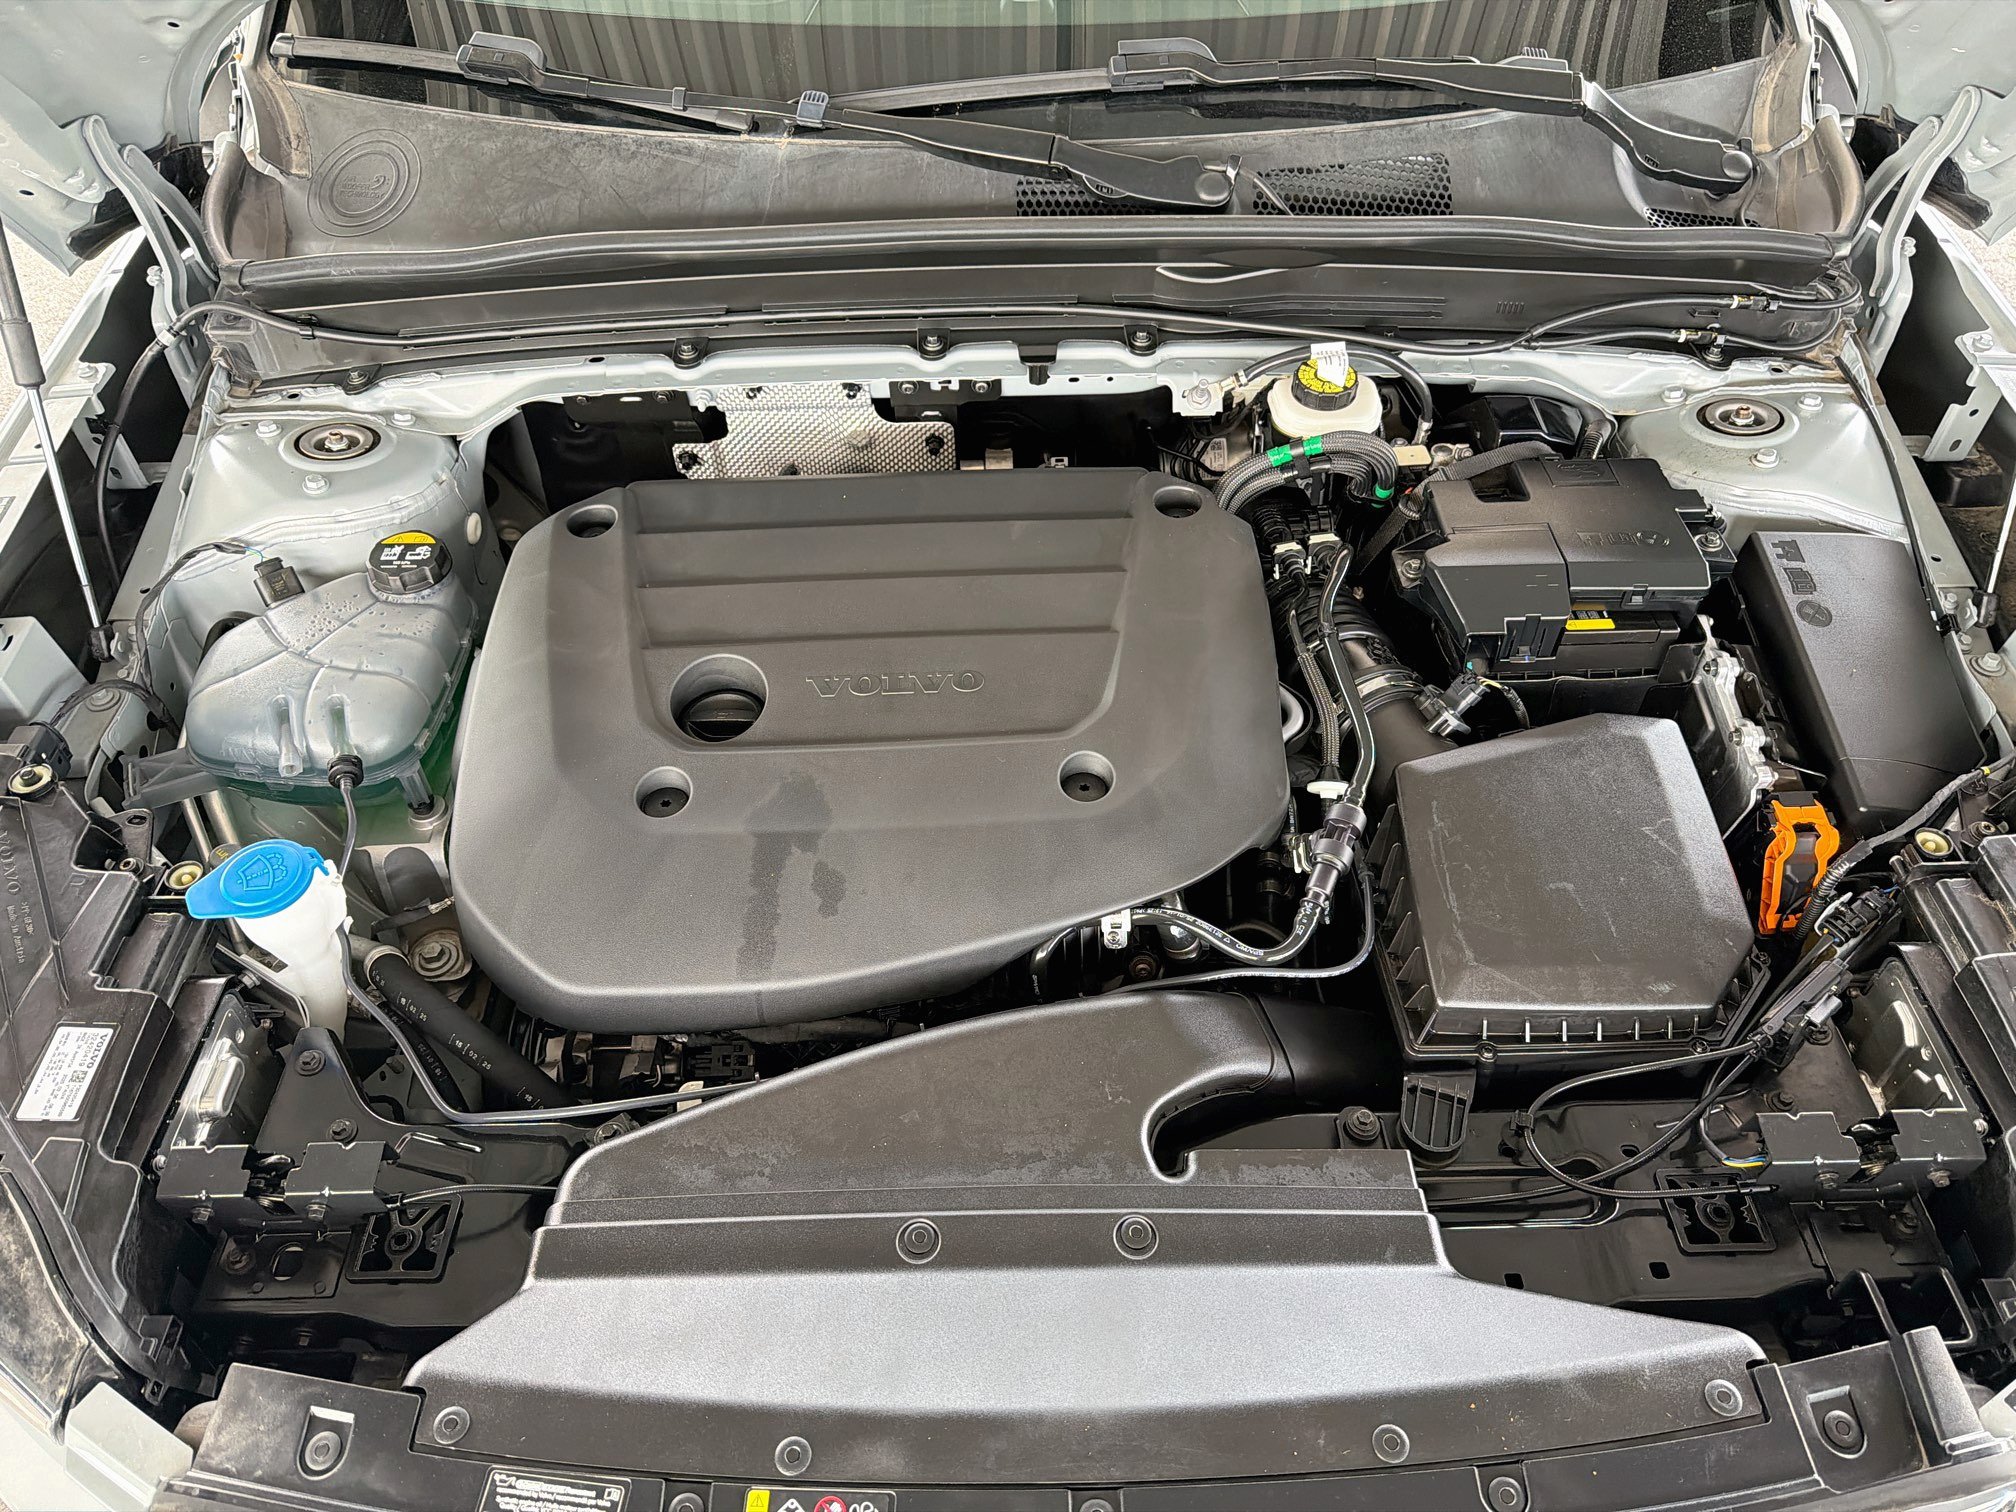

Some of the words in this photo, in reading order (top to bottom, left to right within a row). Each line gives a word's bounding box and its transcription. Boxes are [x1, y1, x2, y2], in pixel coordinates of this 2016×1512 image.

[805, 670, 985, 698] VOLVO
[77, 1032, 99, 1066] 32420419
[85, 1033, 108, 1068] VOLVO
